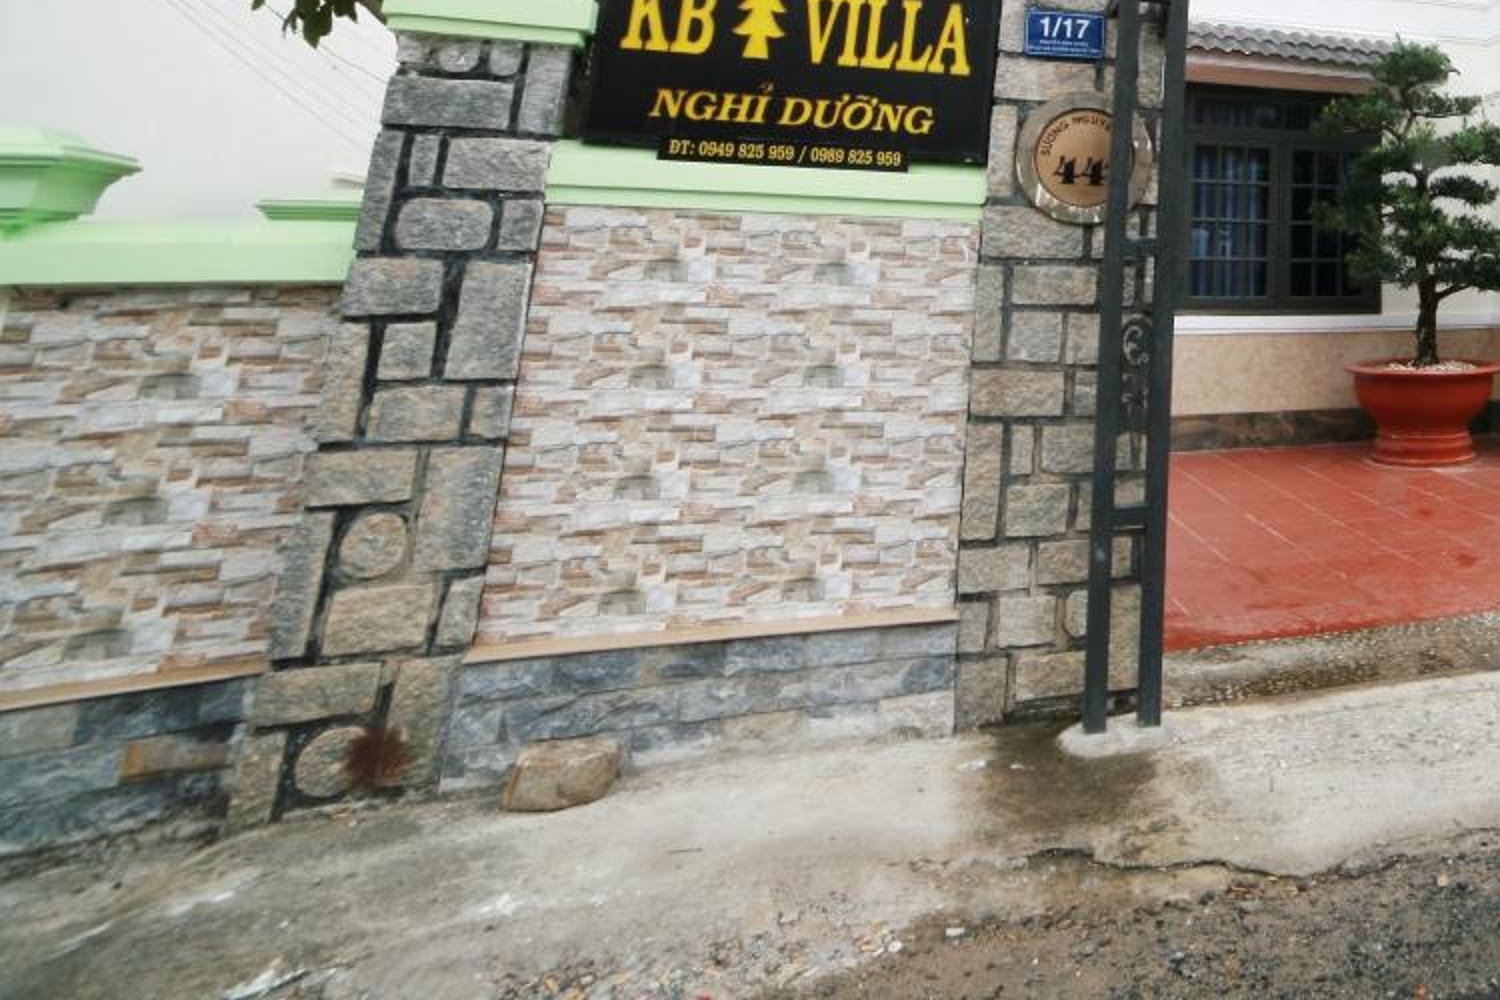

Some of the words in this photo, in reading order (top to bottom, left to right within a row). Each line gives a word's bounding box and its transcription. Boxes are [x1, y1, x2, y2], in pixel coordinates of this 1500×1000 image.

[1040, 15, 1090, 39] 1/17
[649, 82, 774, 124] NGHỈ
[777, 94, 935, 134] DƯỠNG
[698, 141, 735, 157] 0949
[738, 143, 765, 159] 825
[768, 145, 795, 161] 959
[810, 147, 845, 163] 0989
[847, 149, 873, 165] 825
[876, 151, 901, 167] 959
